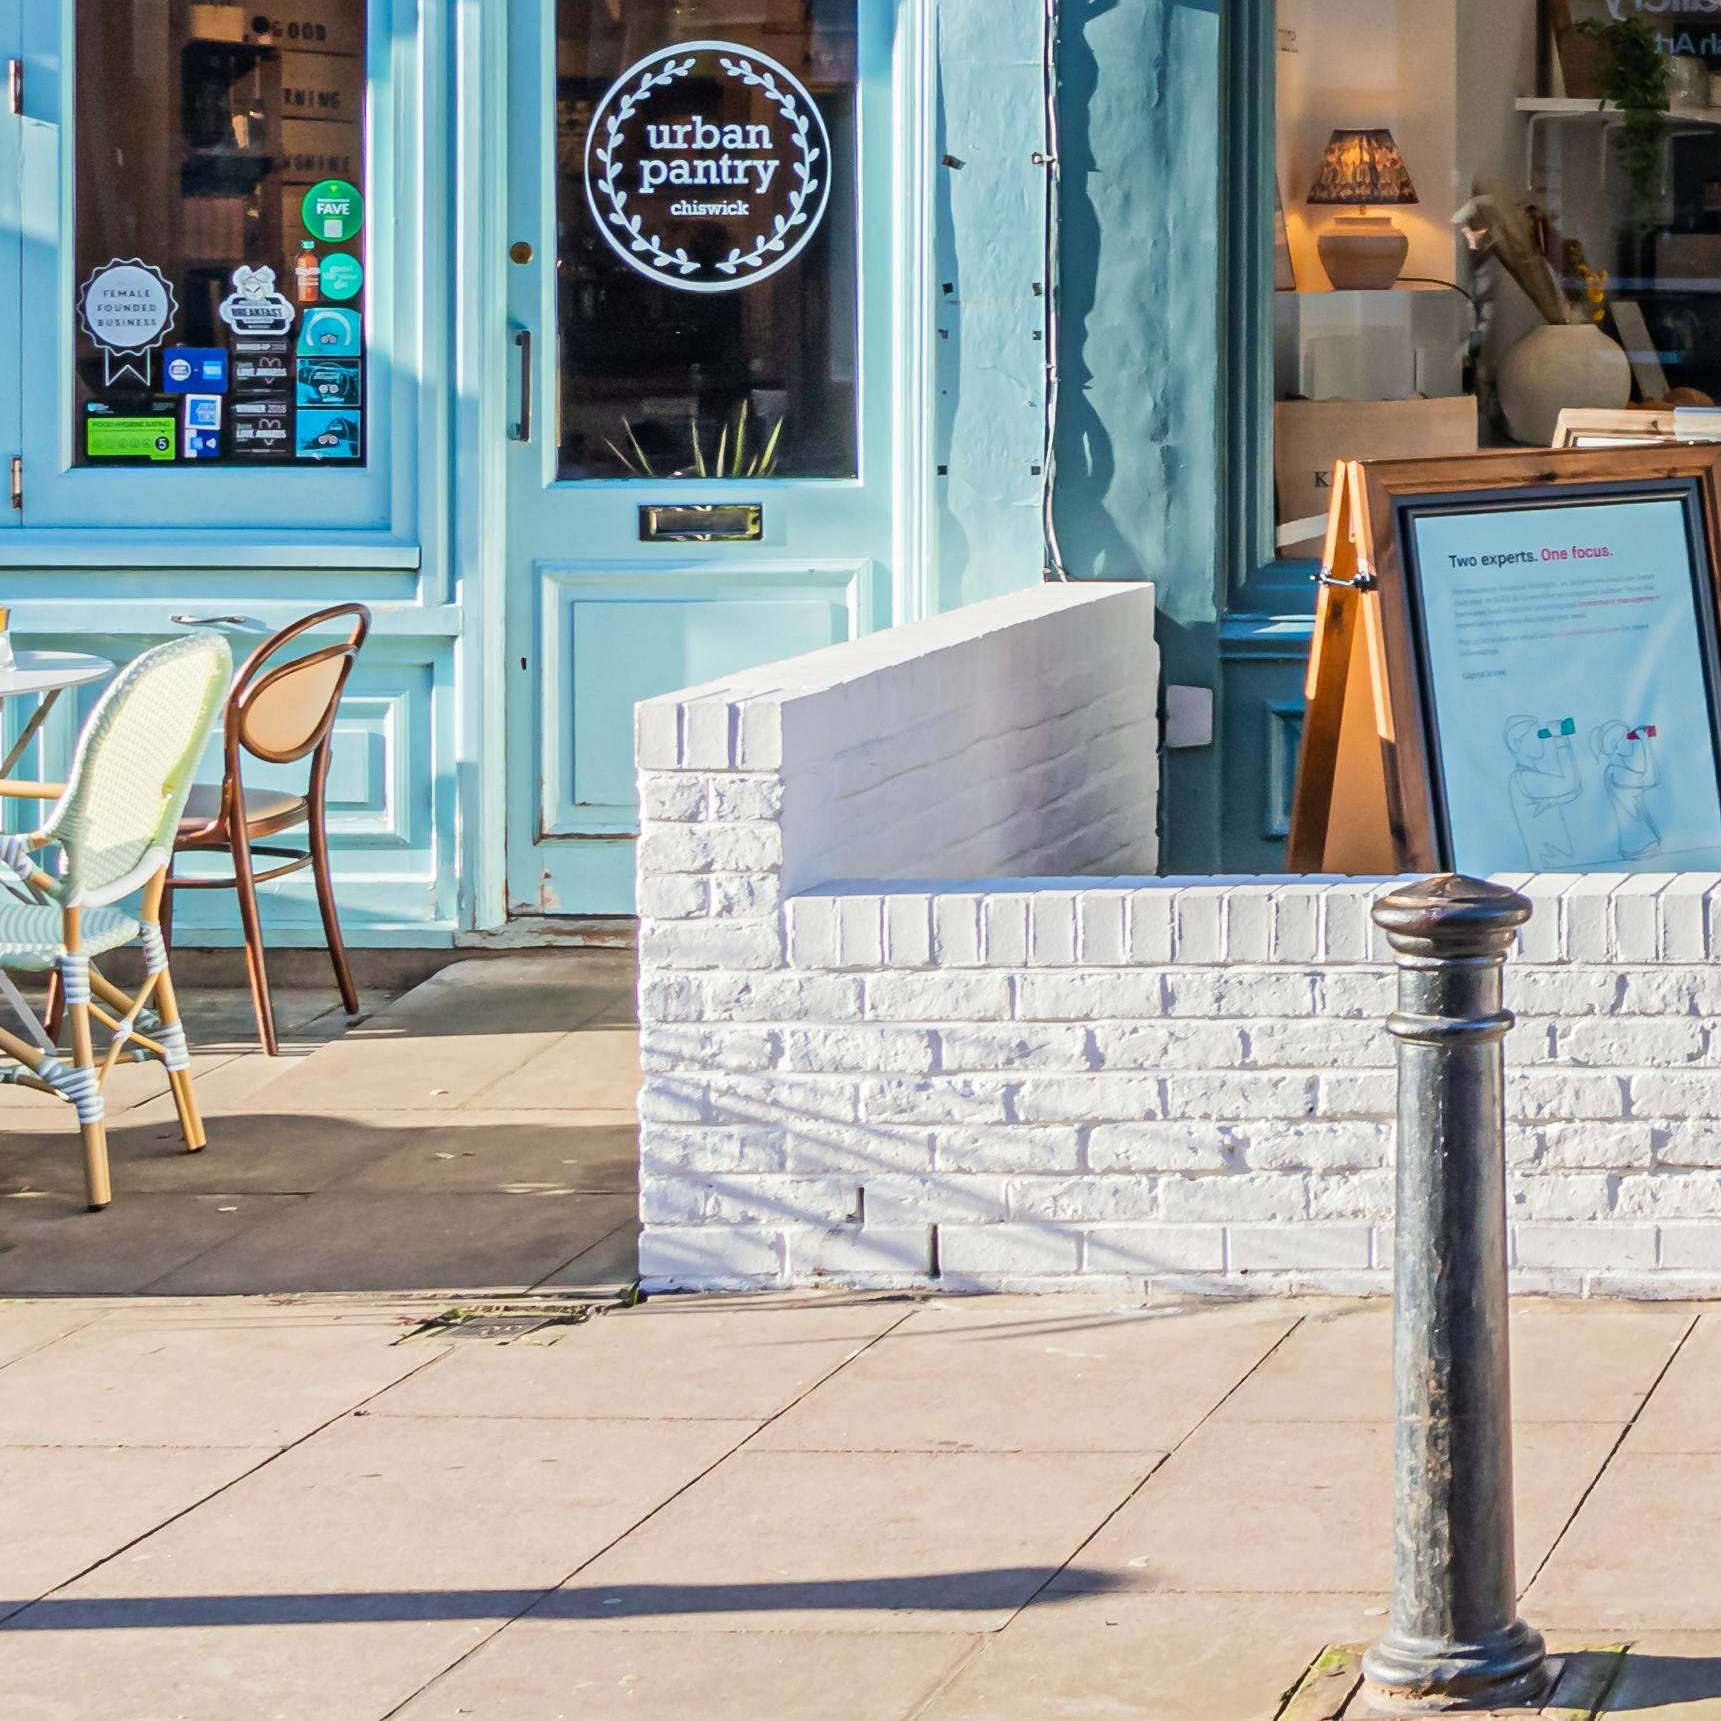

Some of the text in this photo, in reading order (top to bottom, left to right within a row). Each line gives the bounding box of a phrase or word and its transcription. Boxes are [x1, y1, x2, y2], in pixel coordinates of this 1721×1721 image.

[646, 115, 774, 150] urban
[638, 153, 780, 194] pantry
[316, 203, 350, 215] FAVE
[670, 200, 750, 216] chiswick
[103, 289, 150, 298] FEMALE
[97, 304, 157, 312] FOUNDED
[97, 319, 157, 327] BUSINESS
[158, 438, 168, 450] 5
[1449, 545, 1614, 568] Two experts. One focus.
